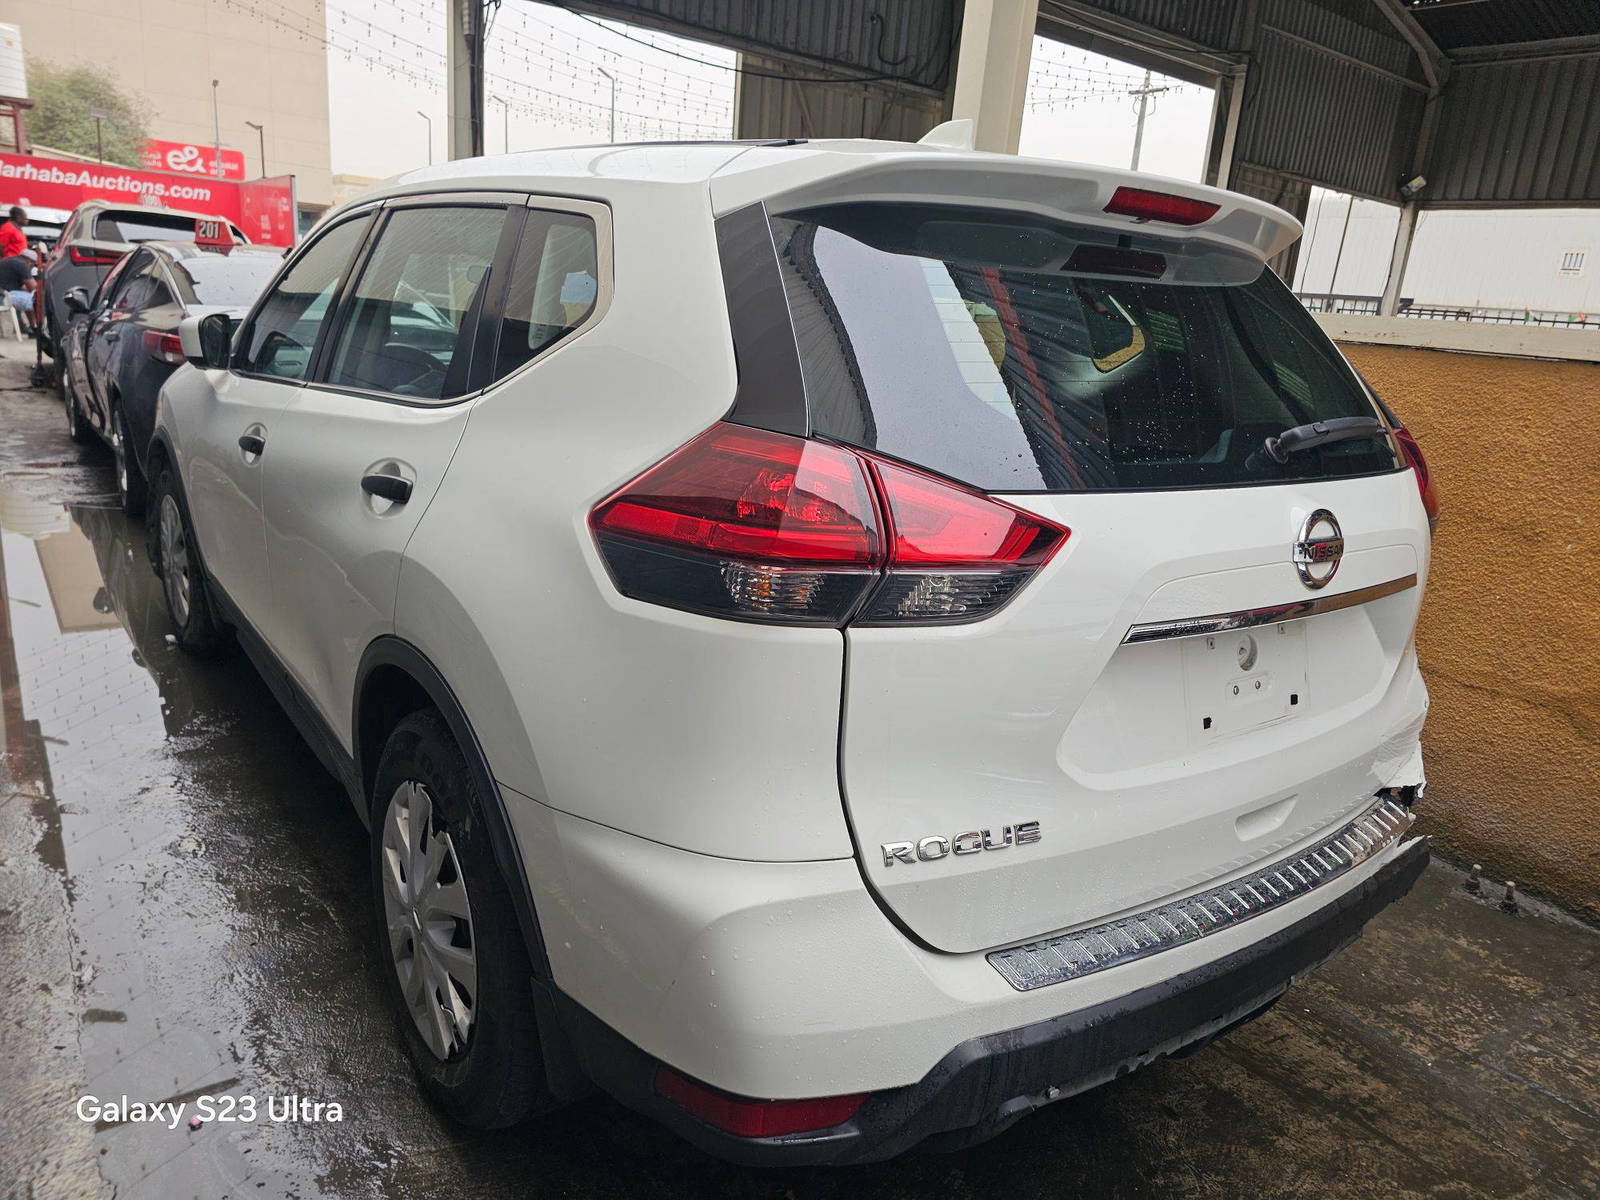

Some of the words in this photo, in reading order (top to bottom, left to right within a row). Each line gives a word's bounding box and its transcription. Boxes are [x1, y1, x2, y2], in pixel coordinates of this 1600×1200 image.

[199, 221, 220, 239] 201
[1303, 545, 1344, 560] NISSA
[880, 820, 1042, 867] ROGUE
